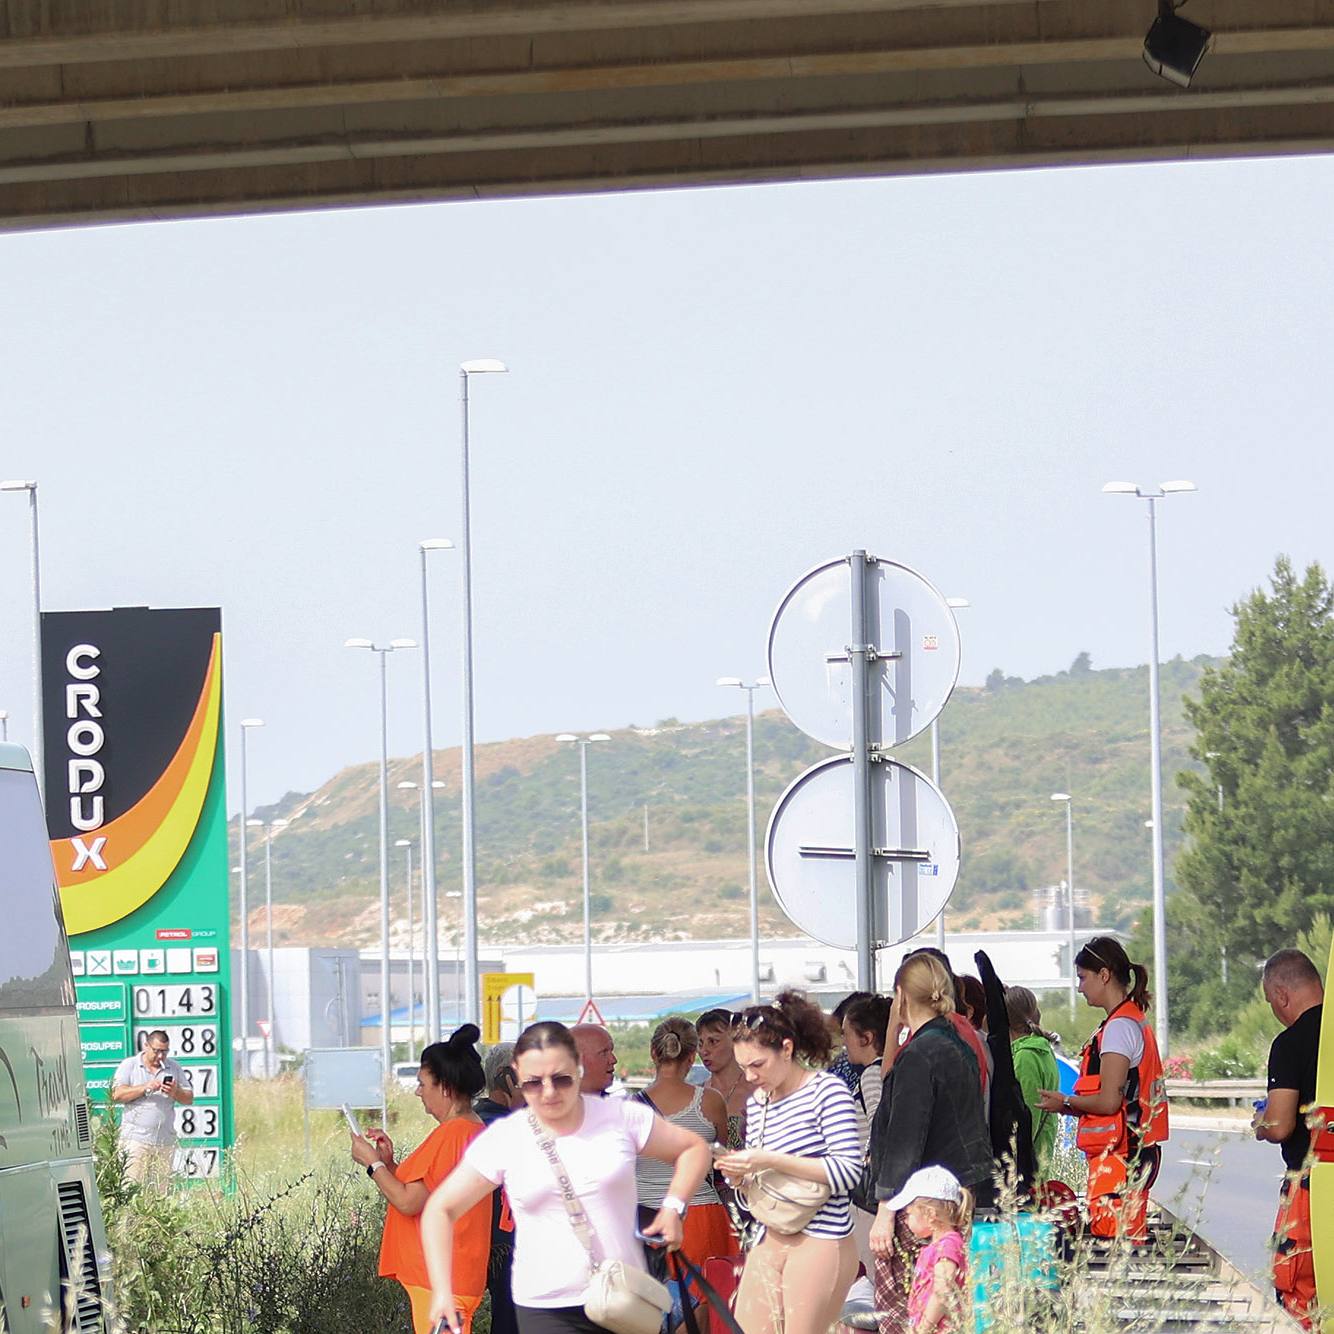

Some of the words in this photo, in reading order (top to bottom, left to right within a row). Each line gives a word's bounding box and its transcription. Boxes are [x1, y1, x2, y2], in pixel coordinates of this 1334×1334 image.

[66, 643, 108, 872] CRODUX
[135, 986, 214, 1015] 01,43
[181, 1108, 217, 1135] 83
